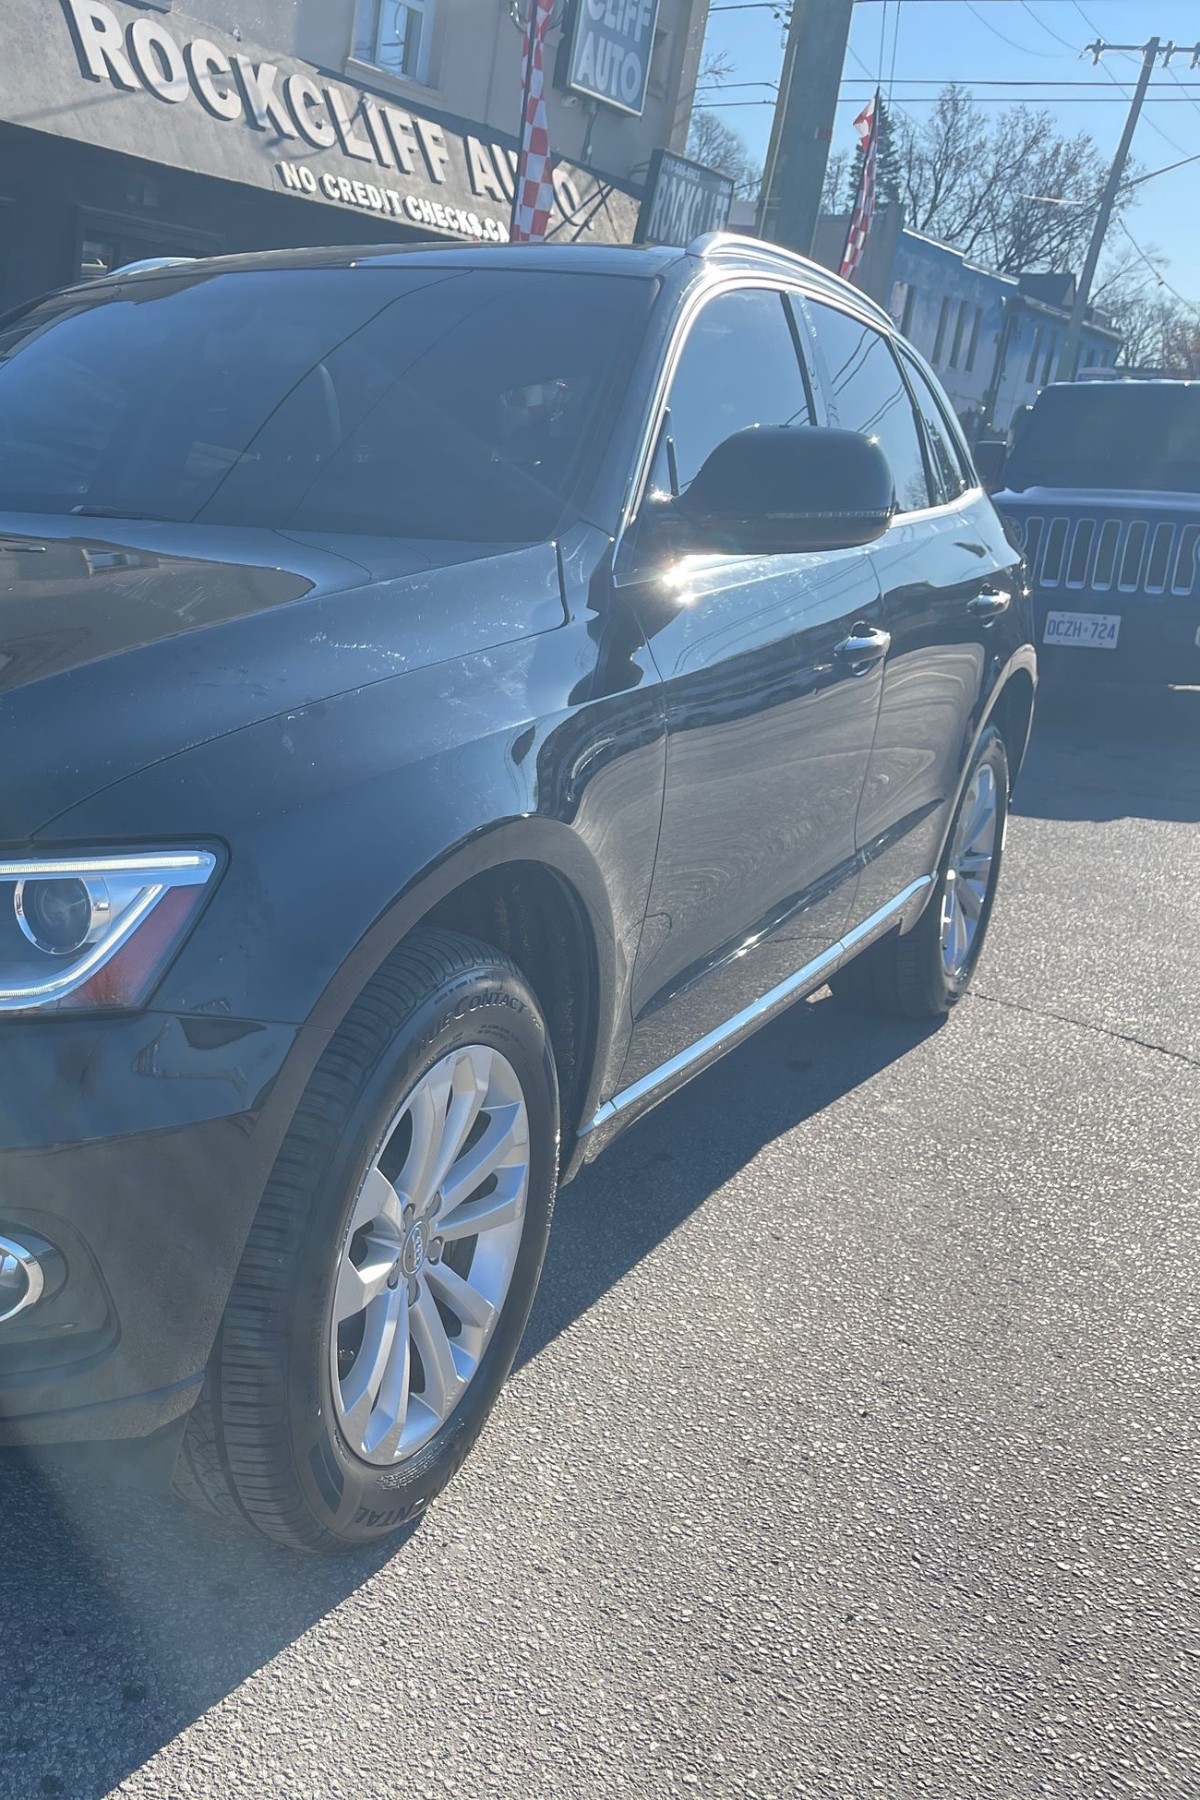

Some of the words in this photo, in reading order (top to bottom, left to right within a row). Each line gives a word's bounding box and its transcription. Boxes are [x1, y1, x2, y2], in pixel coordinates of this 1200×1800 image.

[577, 31, 642, 103] AUTO
[67, 0, 449, 183] ROCKCLIFF
[466, 135, 589, 226] AUO
[281, 160, 317, 192] NO
[322, 173, 402, 214] CREDIT
